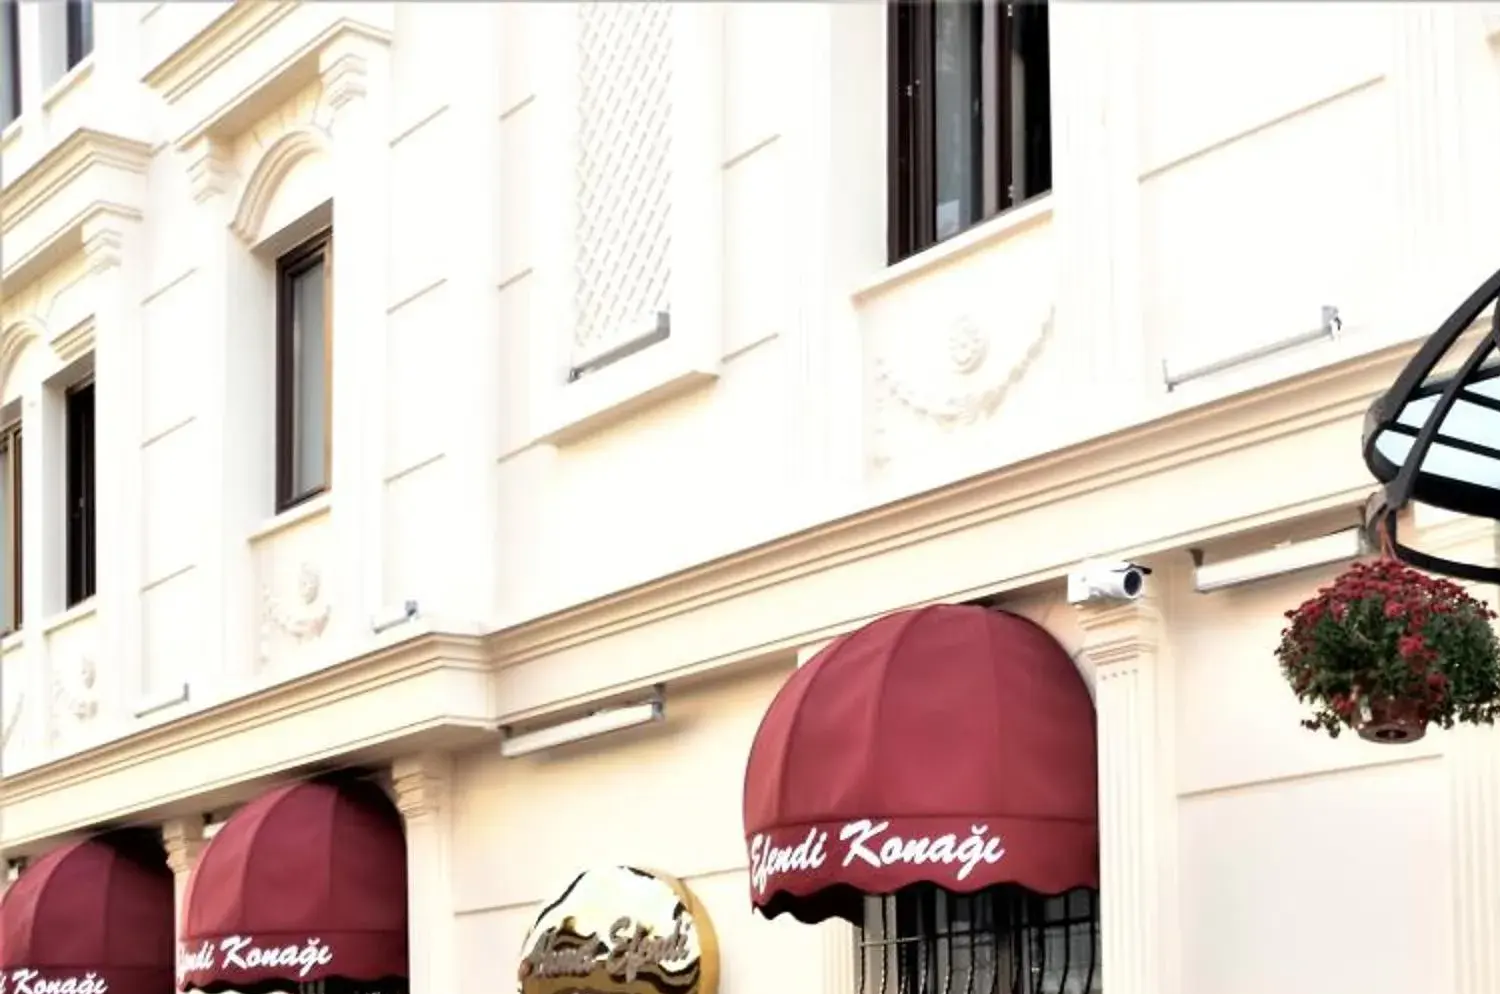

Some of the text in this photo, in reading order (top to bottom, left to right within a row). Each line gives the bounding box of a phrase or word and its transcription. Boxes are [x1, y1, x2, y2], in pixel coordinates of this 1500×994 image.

[751, 819, 1005, 895] Efendi Konağı
[220, 935, 333, 977] Konağı
